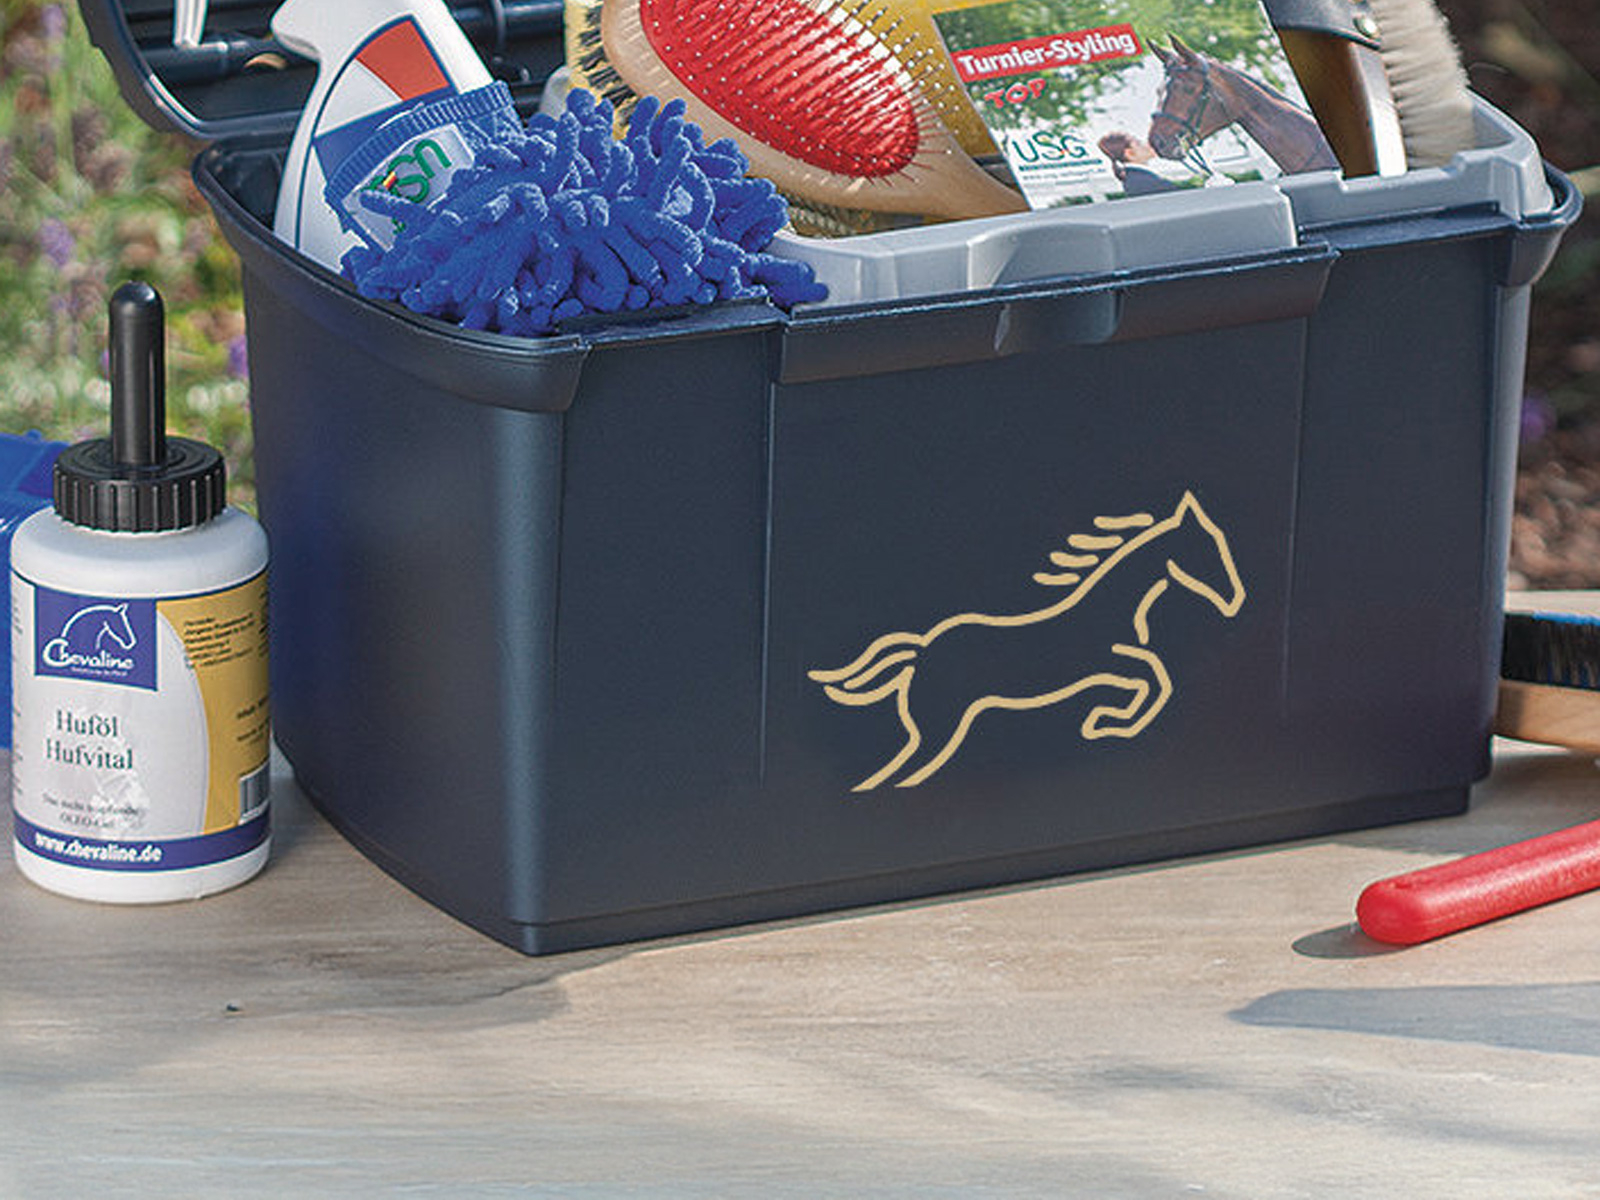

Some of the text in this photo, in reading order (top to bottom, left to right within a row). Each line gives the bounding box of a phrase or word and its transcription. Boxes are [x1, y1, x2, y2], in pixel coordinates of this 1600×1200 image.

[957, 30, 1137, 75] Turnier-Styling
[982, 77, 1047, 109] TOP
[1011, 130, 1087, 163] USG
[42, 638, 134, 670] Chevaline
[56, 709, 118, 737] Huföl
[45, 738, 133, 770] Hufvital
[35, 832, 162, 862] www.chevaline.de
